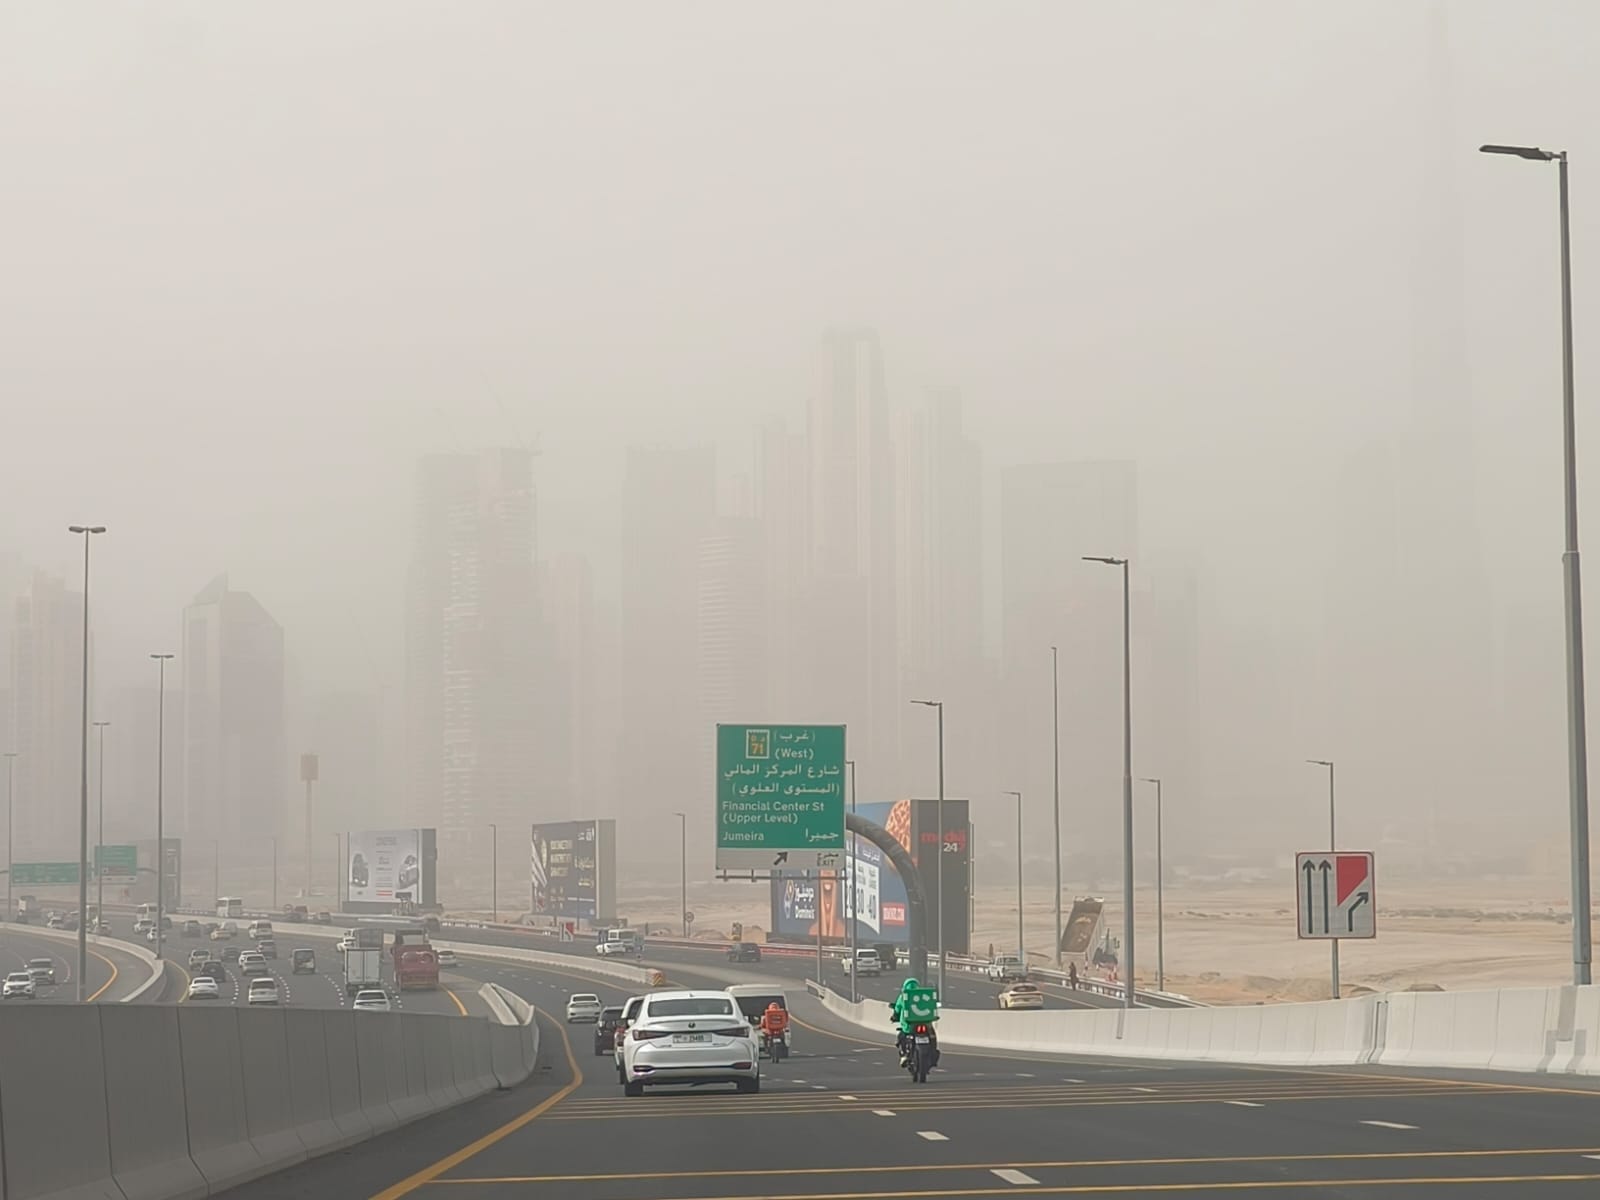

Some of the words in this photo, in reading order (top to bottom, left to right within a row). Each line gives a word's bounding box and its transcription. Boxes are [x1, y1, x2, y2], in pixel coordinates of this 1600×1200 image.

[751, 743, 764, 755] 71
[775, 748, 815, 760] (West)
[724, 763, 760, 780] المالي
[764, 763, 802, 778] المركز
[807, 764, 840, 778] شارع
[722, 801, 770, 811] Financial
[773, 801, 809, 811] Center
[812, 802, 824, 811] St
[723, 813, 761, 824] (Upper
[764, 813, 798, 824] Level)
[722, 831, 764, 841] Jumeira
[805, 828, 839, 842] جميرا
[943, 842, 958, 853] 24
